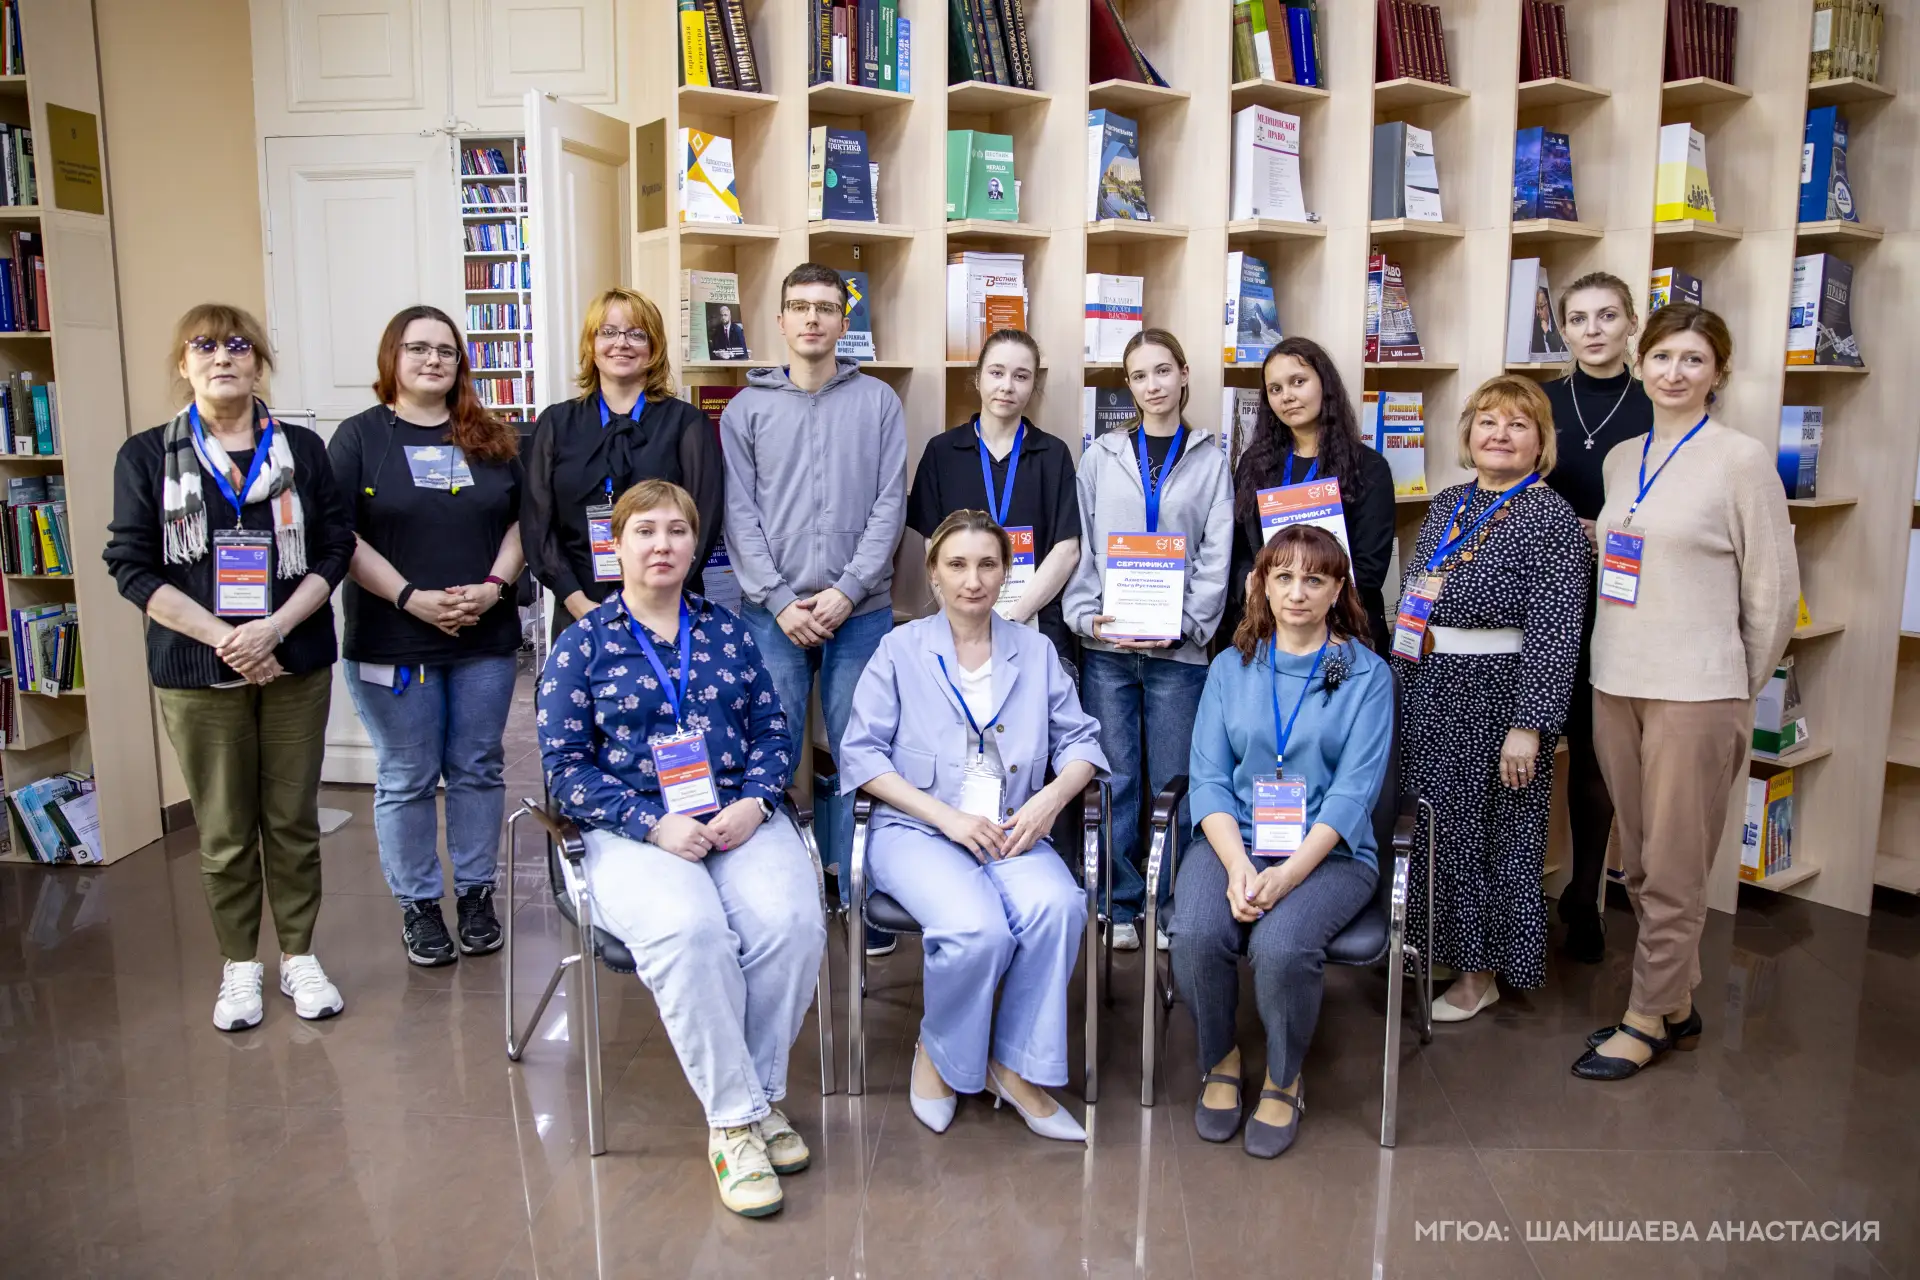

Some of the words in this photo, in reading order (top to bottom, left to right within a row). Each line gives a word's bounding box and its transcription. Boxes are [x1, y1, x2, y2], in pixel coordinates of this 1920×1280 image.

[1008, 21, 1014, 29] И
[704, 2, 730, 78] ГЛОБАЛИСТИКА
[728, 5, 755, 80] ГЛОБАЛИСТИКА
[1009, 30, 1024, 82] ЭКОНОМИКА
[1020, 31, 1034, 82] ЭКОНОМИКА
[1257, 113, 1296, 131] МЕДИЦИНСКОЕ
[1267, 129, 1286, 142] ПРАВО
[983, 275, 1018, 287] ВЕСТНИК
[1827, 284, 1847, 301] ПРАВО
[1403, 436, 1419, 448] LAW
[1271, 508, 1332, 524] СЕРТИФИКАТ
[1116, 560, 1175, 568] СЕРТИФИКАТ
